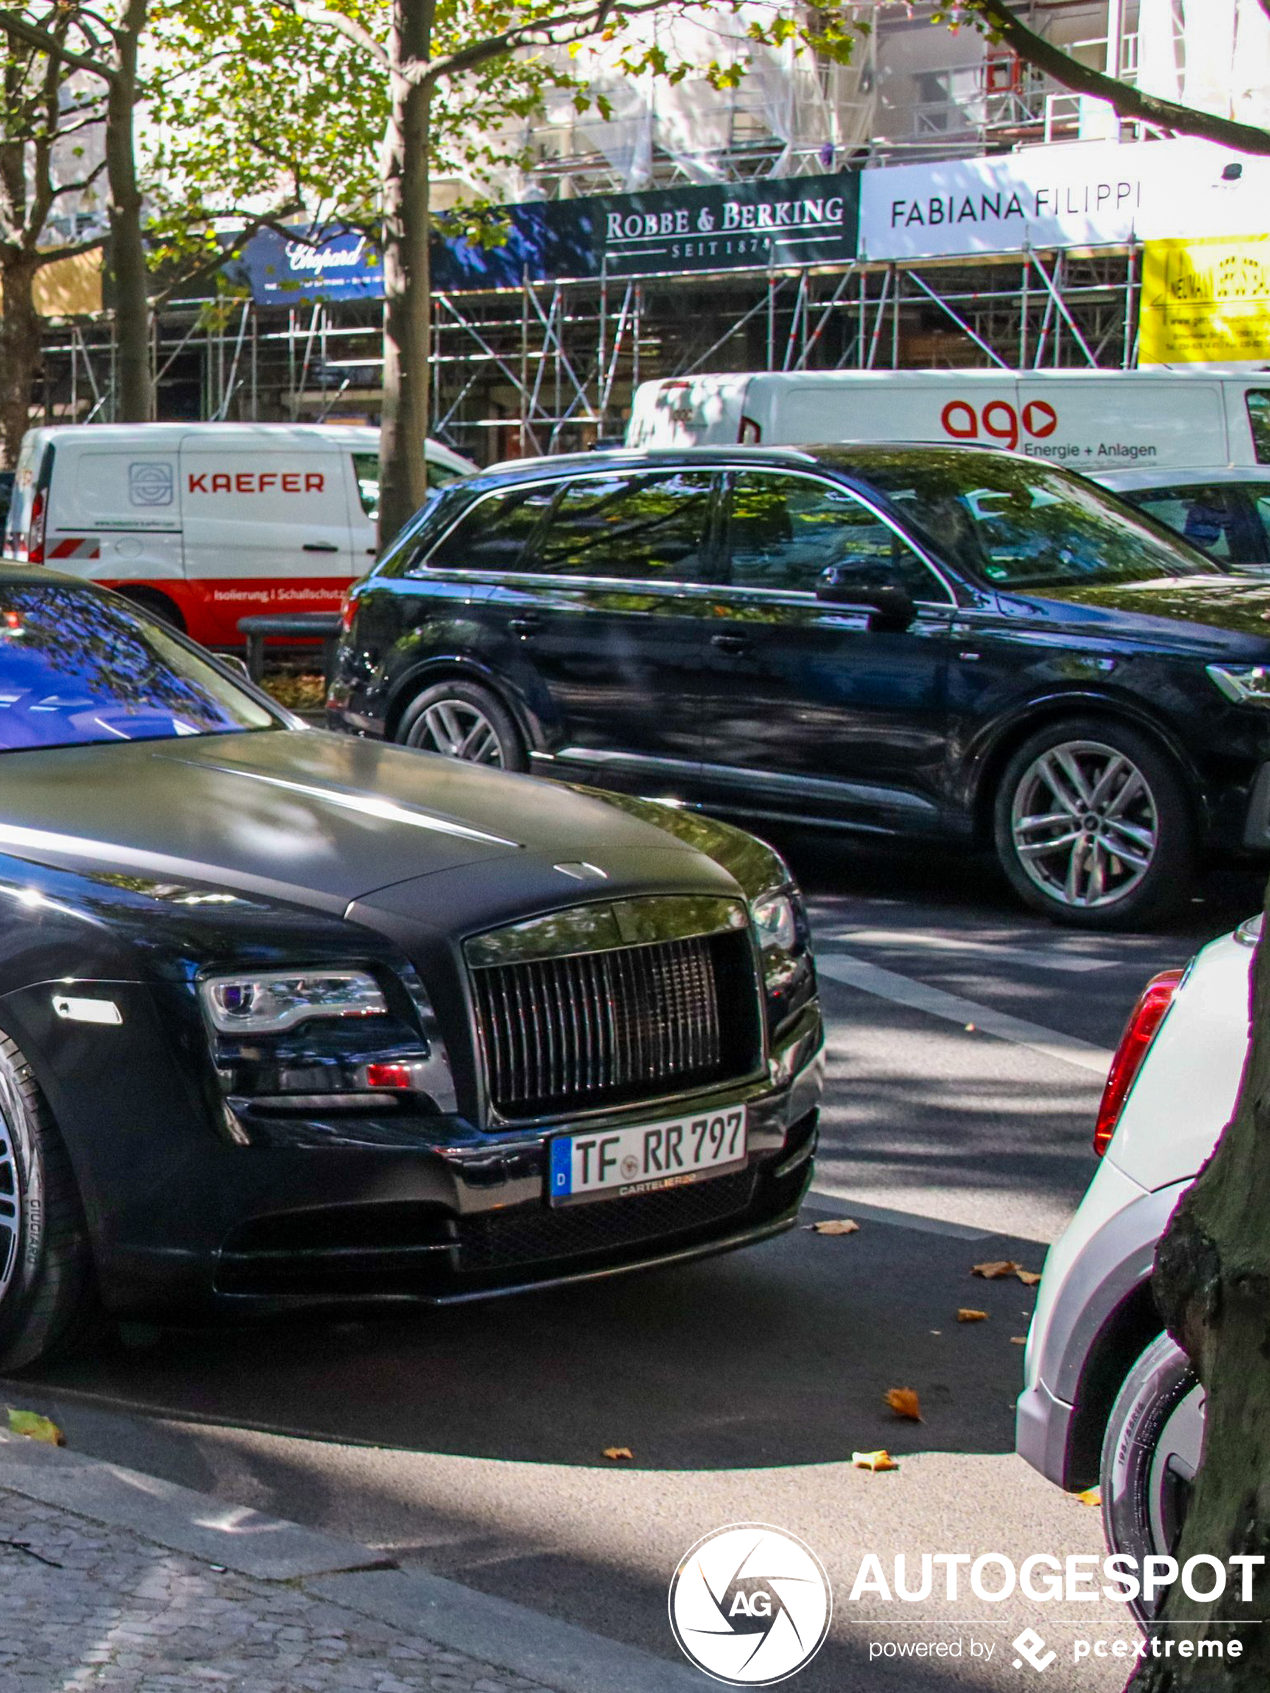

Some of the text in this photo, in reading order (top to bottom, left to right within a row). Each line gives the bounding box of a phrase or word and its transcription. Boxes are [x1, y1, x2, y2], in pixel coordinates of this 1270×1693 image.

[606, 197, 844, 239] ROBBE & BERKING
[891, 181, 1140, 228] FABIANA FILIPPI
[285, 236, 367, 275] Chopard
[672, 238, 770, 258] SEIT 1874
[1024, 443, 1080, 459] Energie
[1097, 443, 1157, 459] Anlagen
[188, 473, 325, 494] KAEFER
[576, 1111, 742, 1184] TF RR 797
[557, 1173, 566, 1186] D
